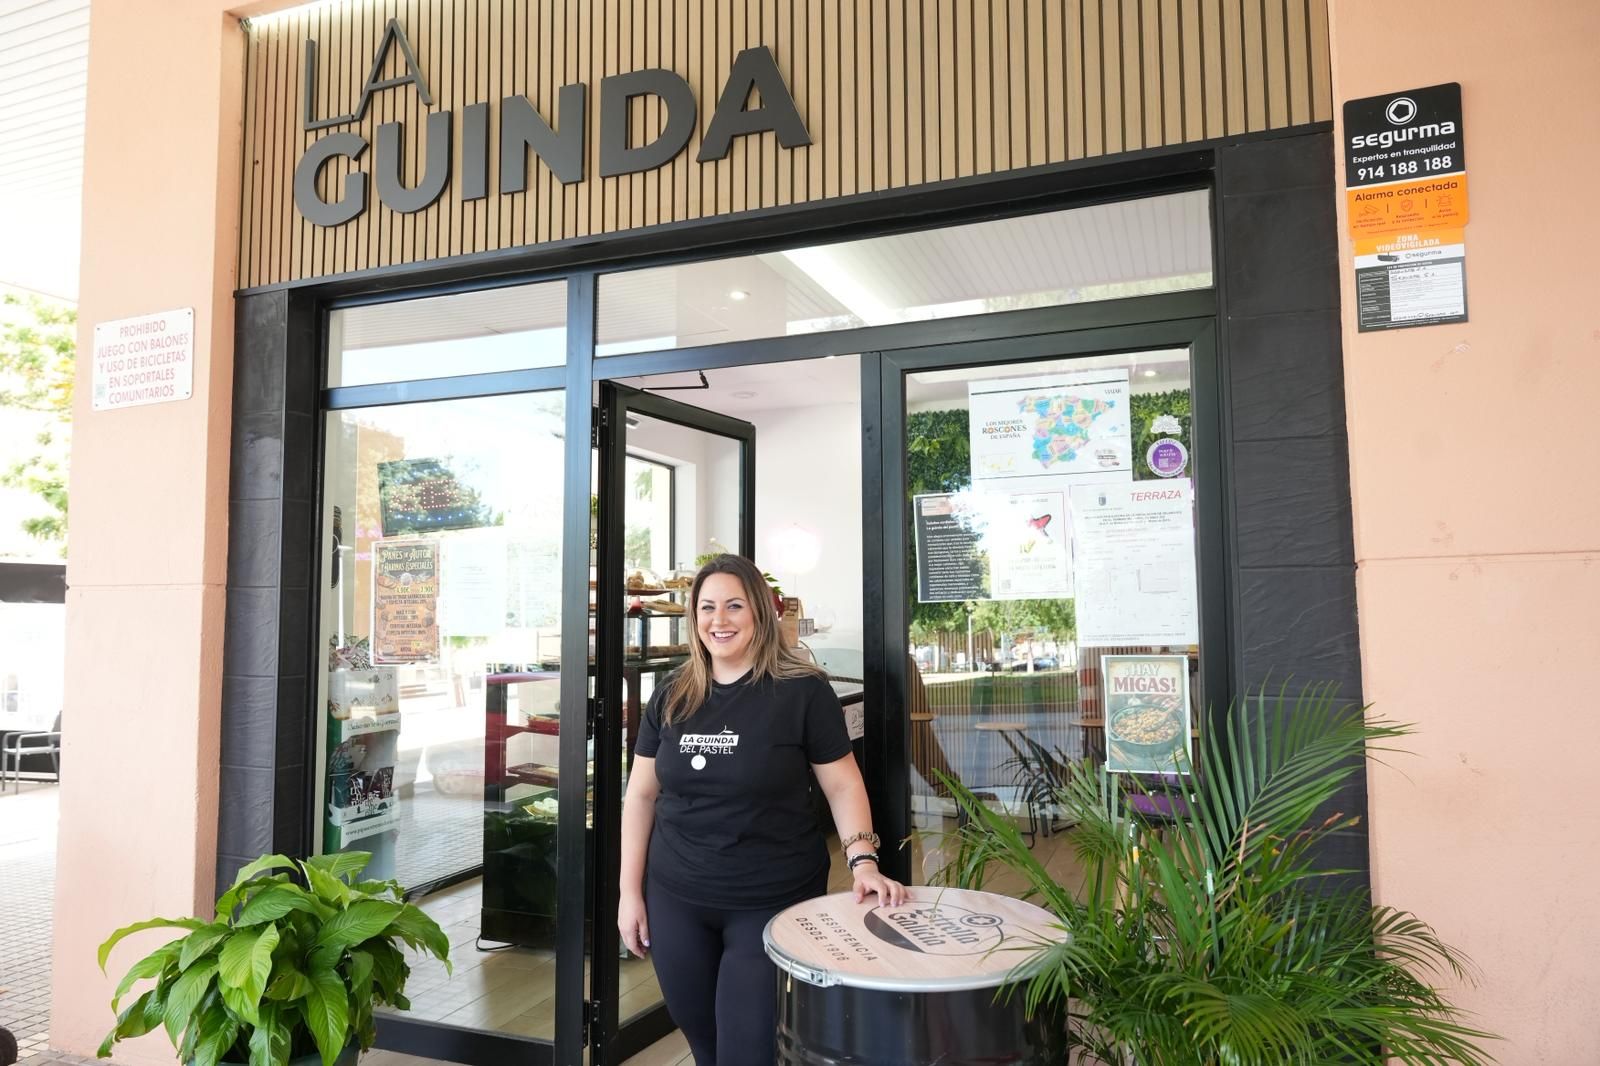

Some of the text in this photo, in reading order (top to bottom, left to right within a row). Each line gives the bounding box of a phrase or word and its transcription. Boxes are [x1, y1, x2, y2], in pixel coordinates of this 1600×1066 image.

[304, 17, 434, 131] LA
[293, 45, 813, 227] GUINDA
[1352, 121, 1455, 149] segurma
[1353, 153, 1388, 163] Expertos
[1403, 141, 1456, 156] tranquilidad
[1358, 155, 1452, 180] 914 188 188
[1355, 181, 1458, 202] Alarma conectada
[1376, 238, 1441, 253] VIDEOVIGILADA
[1397, 233, 1419, 243] ZONA
[120, 320, 166, 338] PROHIBIDO
[97, 333, 189, 359] JUEGO CON BALONES
[100, 350, 186, 373] Y USO DE BICICLETAS
[109, 368, 175, 389] EN SOPORTALES
[109, 384, 174, 405] COMUNITARIOS
[982, 424, 1027, 434] ROSCONES
[1130, 490, 1182, 502] TERRAZA
[382, 550, 403, 562] PANES
[406, 561, 433, 572] ESPECIALES
[1113, 676, 1177, 693] MIGAS!
[680, 744, 734, 755] DEL PASTEL
[696, 736, 734, 744] GUINDA
[795, 917, 849, 961] DESDE 1906
[816, 912, 878, 961] RESISTENCIA
[887, 911, 946, 946] Galicia
